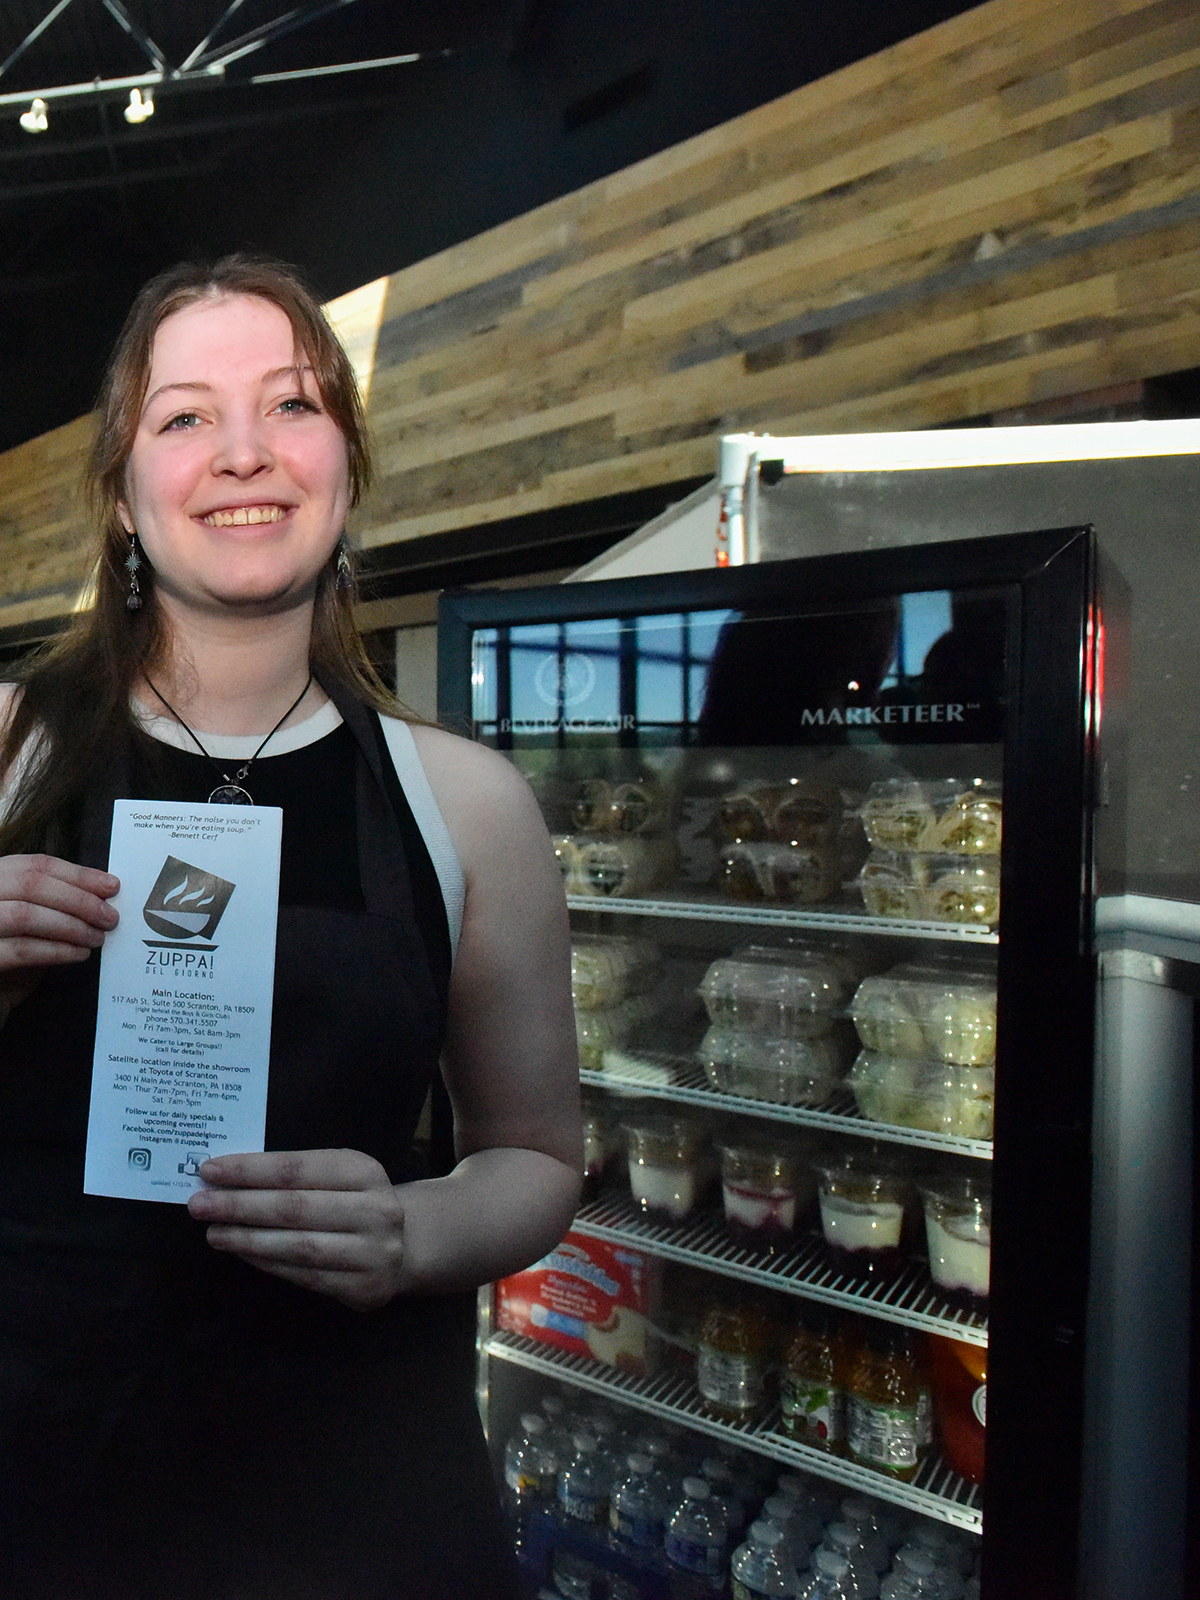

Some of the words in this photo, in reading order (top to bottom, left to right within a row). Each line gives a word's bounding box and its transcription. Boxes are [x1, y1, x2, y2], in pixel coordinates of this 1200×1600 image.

[800, 703, 965, 726] MARKETEER
[241, 818, 260, 826] don't
[176, 824, 199, 832] you're
[201, 825, 225, 833] eating
[146, 951, 214, 970] ZUPPA!
[146, 966, 164, 975] DEL
[175, 969, 214, 979] GIORNO
[152, 989, 172, 998] Main
[174, 991, 215, 1001] Location:
[187, 1002, 221, 1012] Scranton,
[235, 1006, 255, 1014] 18509
[146, 1015, 168, 1024] phone
[177, 1040, 195, 1048] Large
[108, 1055, 139, 1064] Satellite
[141, 1058, 171, 1066] location
[173, 1061, 195, 1069] inside
[212, 1064, 250, 1074] showroom
[150, 1068, 174, 1077] Toyota
[185, 1071, 218, 1080] Scranton
[115, 1074, 132, 1082] 3400
[159, 1078, 172, 1086] Ave
[174, 1079, 208, 1089] Scranton,
[135, 1085, 151, 1093] Thur
[192, 1090, 202, 1098] Fri
[152, 1096, 164, 1104] Sat
[126, 1107, 148, 1116] Follow
[172, 1112, 187, 1120] daily
[190, 1113, 217, 1122] specials
[144, 1118, 177, 1128] upcoming
[140, 1134, 173, 1144] Instagram
